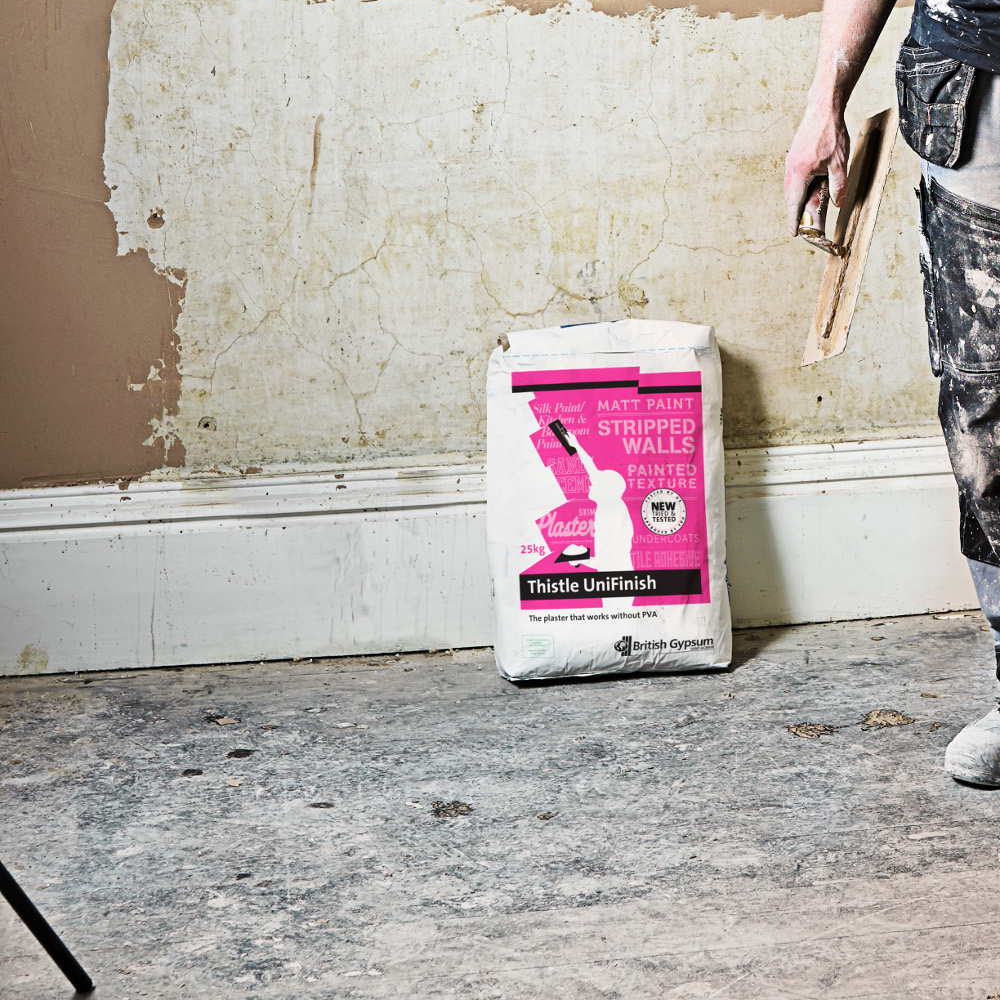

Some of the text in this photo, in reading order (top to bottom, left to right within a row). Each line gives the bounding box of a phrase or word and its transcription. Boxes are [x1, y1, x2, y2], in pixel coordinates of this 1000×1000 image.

[534, 403, 552, 414] Silk
[597, 397, 695, 412] MATT PAINT
[577, 413, 587, 424] &
[597, 418, 696, 436] STRIPPED
[536, 438, 562, 450] Pain
[622, 436, 696, 454] WALLS
[627, 463, 697, 476] PAINTED
[627, 478, 697, 489] TEXTURE
[651, 502, 676, 511] NEW
[632, 533, 700, 544] UNDERCOATS
[520, 544, 546, 556] 25kg
[527, 575, 657, 594] Thistle UniFinish
[543, 614, 568, 623] plaster
[570, 613, 585, 621] that
[610, 611, 641, 620] without
[633, 637, 714, 651] British Gypsum
